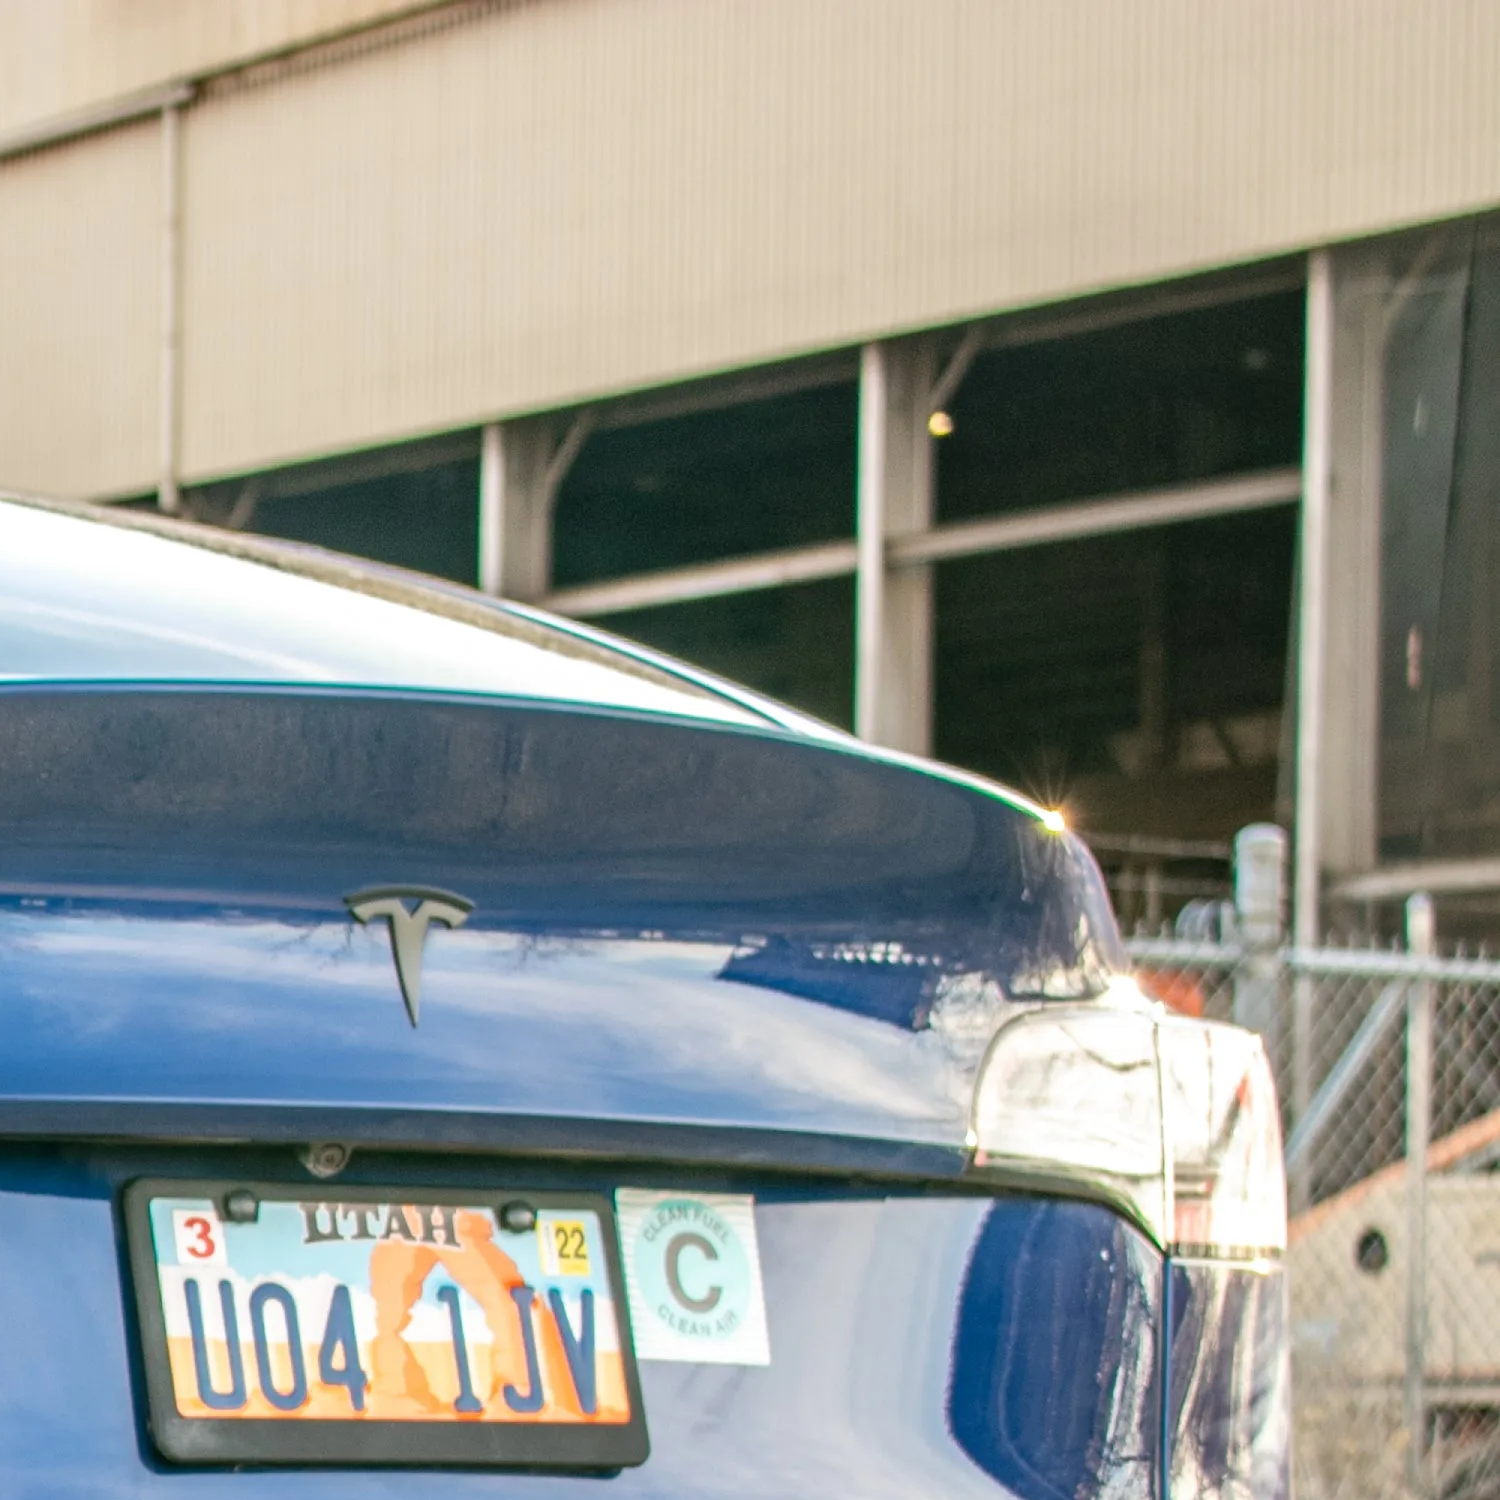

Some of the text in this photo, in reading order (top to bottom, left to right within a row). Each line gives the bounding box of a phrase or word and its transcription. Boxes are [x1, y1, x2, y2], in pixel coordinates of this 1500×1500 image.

[184, 1217, 215, 1258] 3
[303, 1202, 462, 1249] UTAH
[555, 1226, 588, 1260] 22
[643, 1205, 731, 1244] CLEAN FUEL
[665, 1231, 723, 1314] C
[658, 1303, 737, 1336] CLEAN AIR
